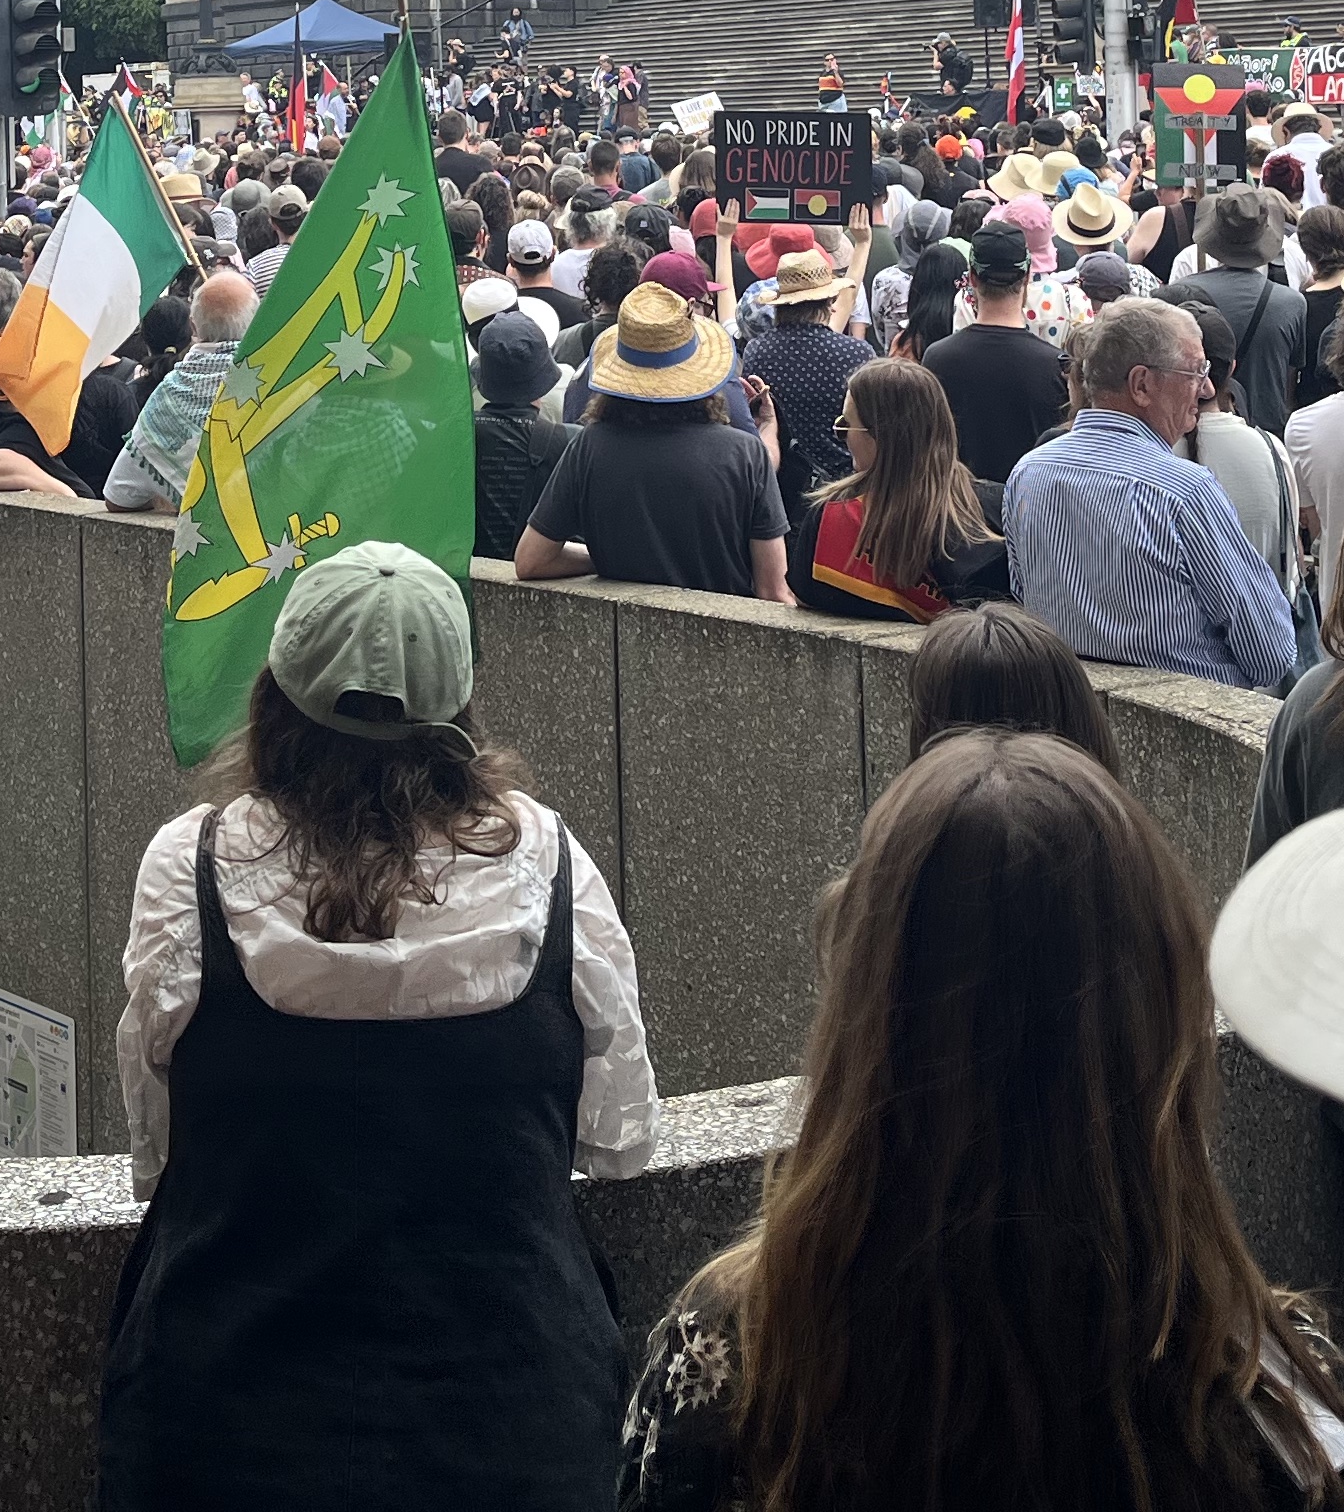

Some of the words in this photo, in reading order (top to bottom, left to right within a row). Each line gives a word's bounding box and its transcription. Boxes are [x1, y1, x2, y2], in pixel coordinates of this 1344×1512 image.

[686, 101, 703, 114] LIVE
[725, 118, 755, 146] NO
[765, 119, 820, 146] PRIDE
[829, 121, 853, 147] IN
[725, 147, 855, 185] GENOCIDE
